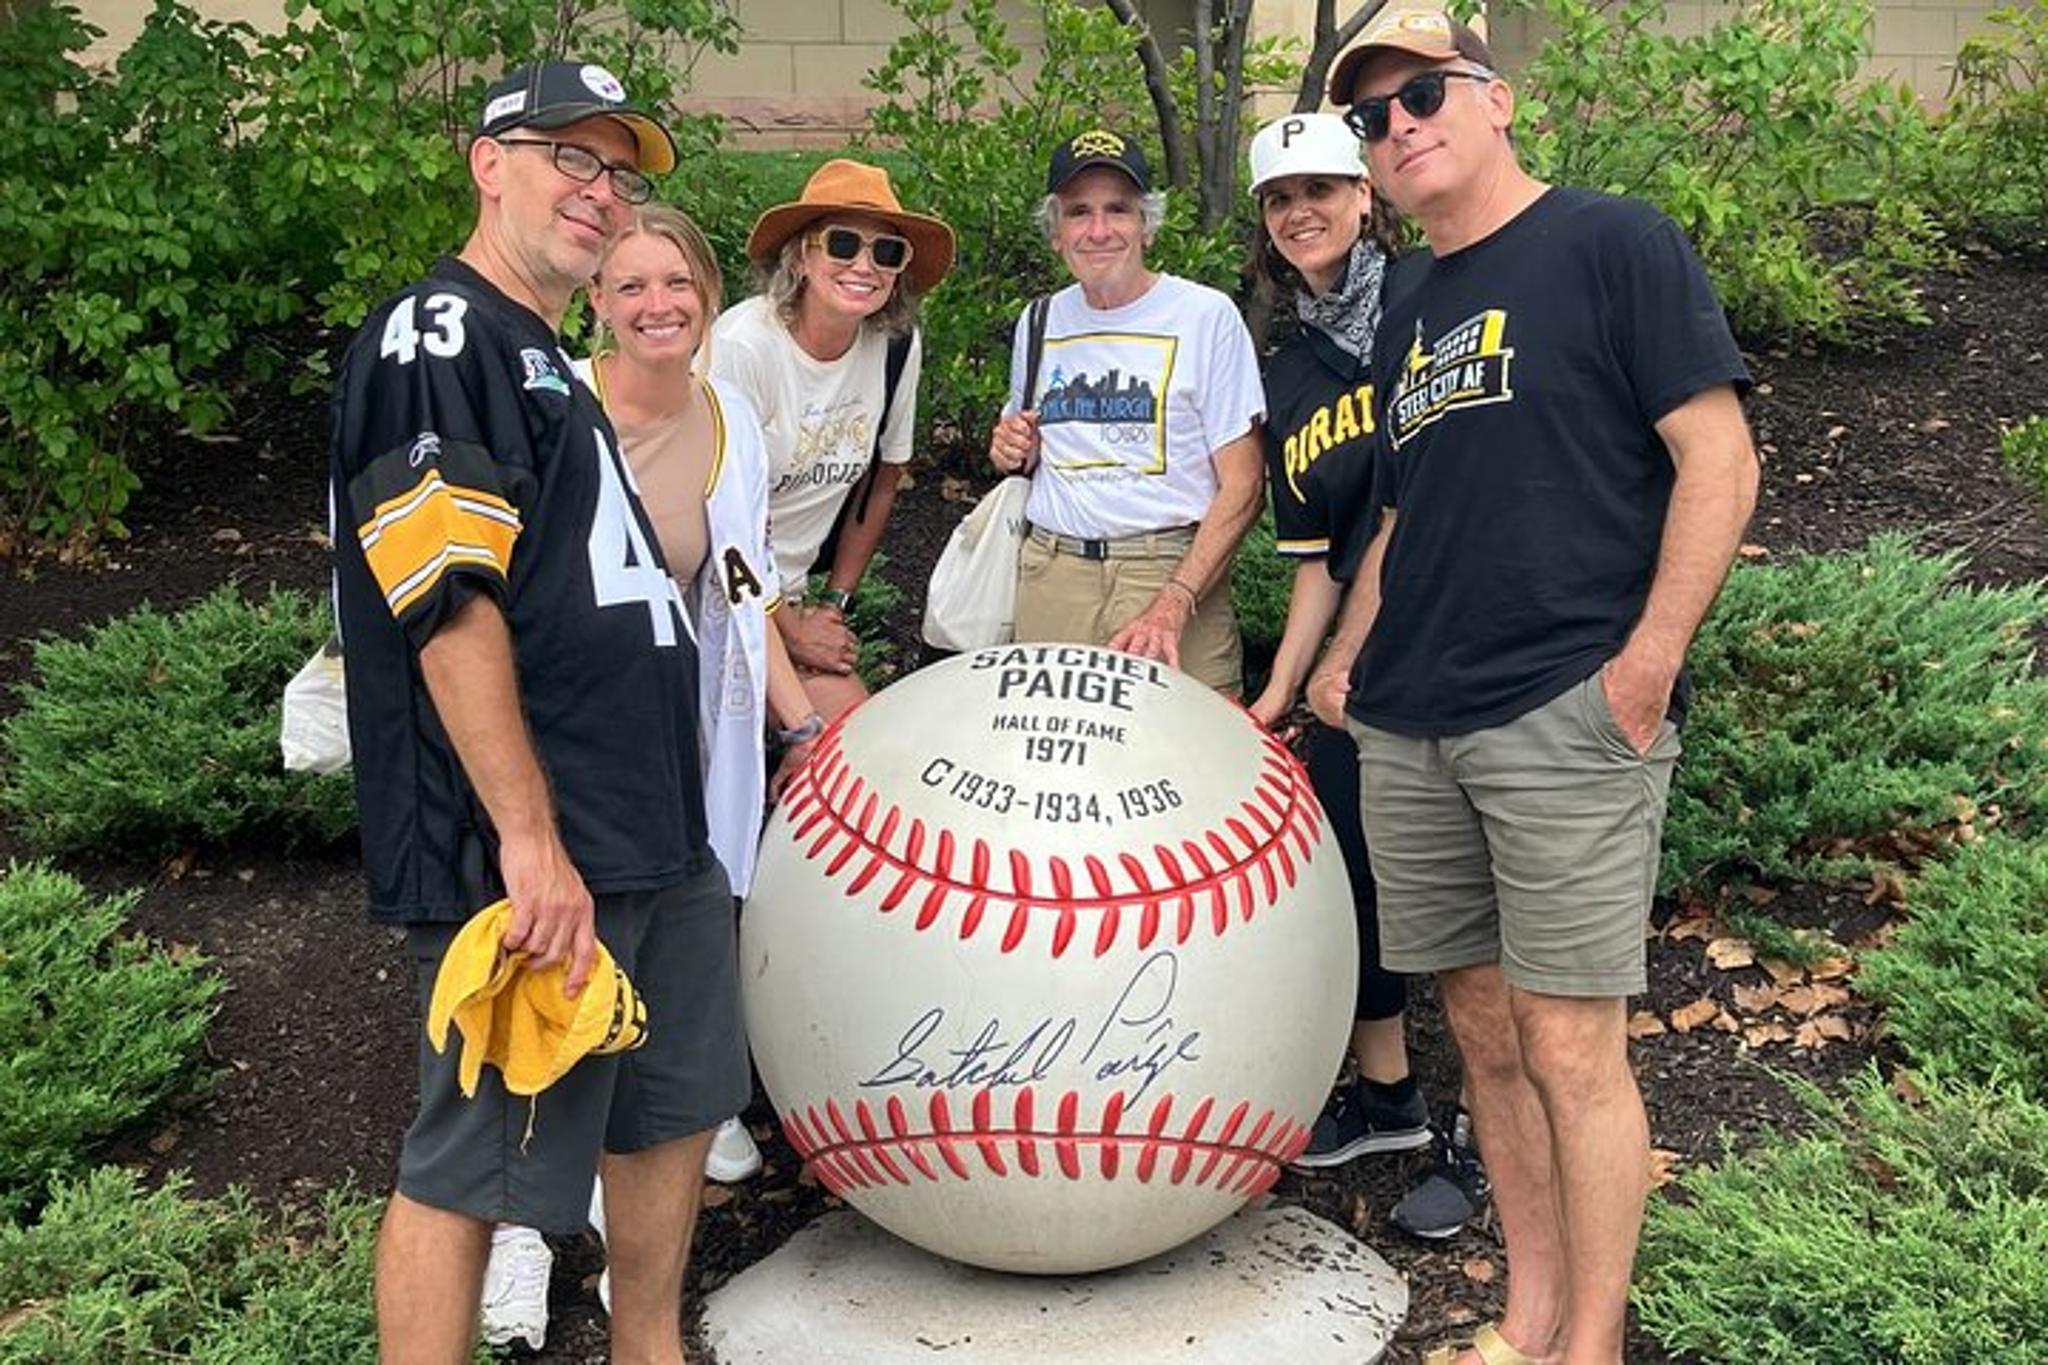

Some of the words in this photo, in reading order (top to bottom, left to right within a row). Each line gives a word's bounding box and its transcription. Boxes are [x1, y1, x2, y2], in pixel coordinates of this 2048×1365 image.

[1282, 119, 1305, 149] P
[380, 293, 468, 365] 43
[1462, 360, 1485, 389] AF
[971, 647, 1169, 689] SATCHEL
[997, 668, 1134, 712] PAIGE
[991, 714, 1041, 732] HALL
[1046, 715, 1071, 735] OF
[1075, 718, 1127, 744] FAME
[1024, 737, 1088, 767] 1971
[920, 757, 955, 787] C
[1116, 778, 1183, 820] 1936
